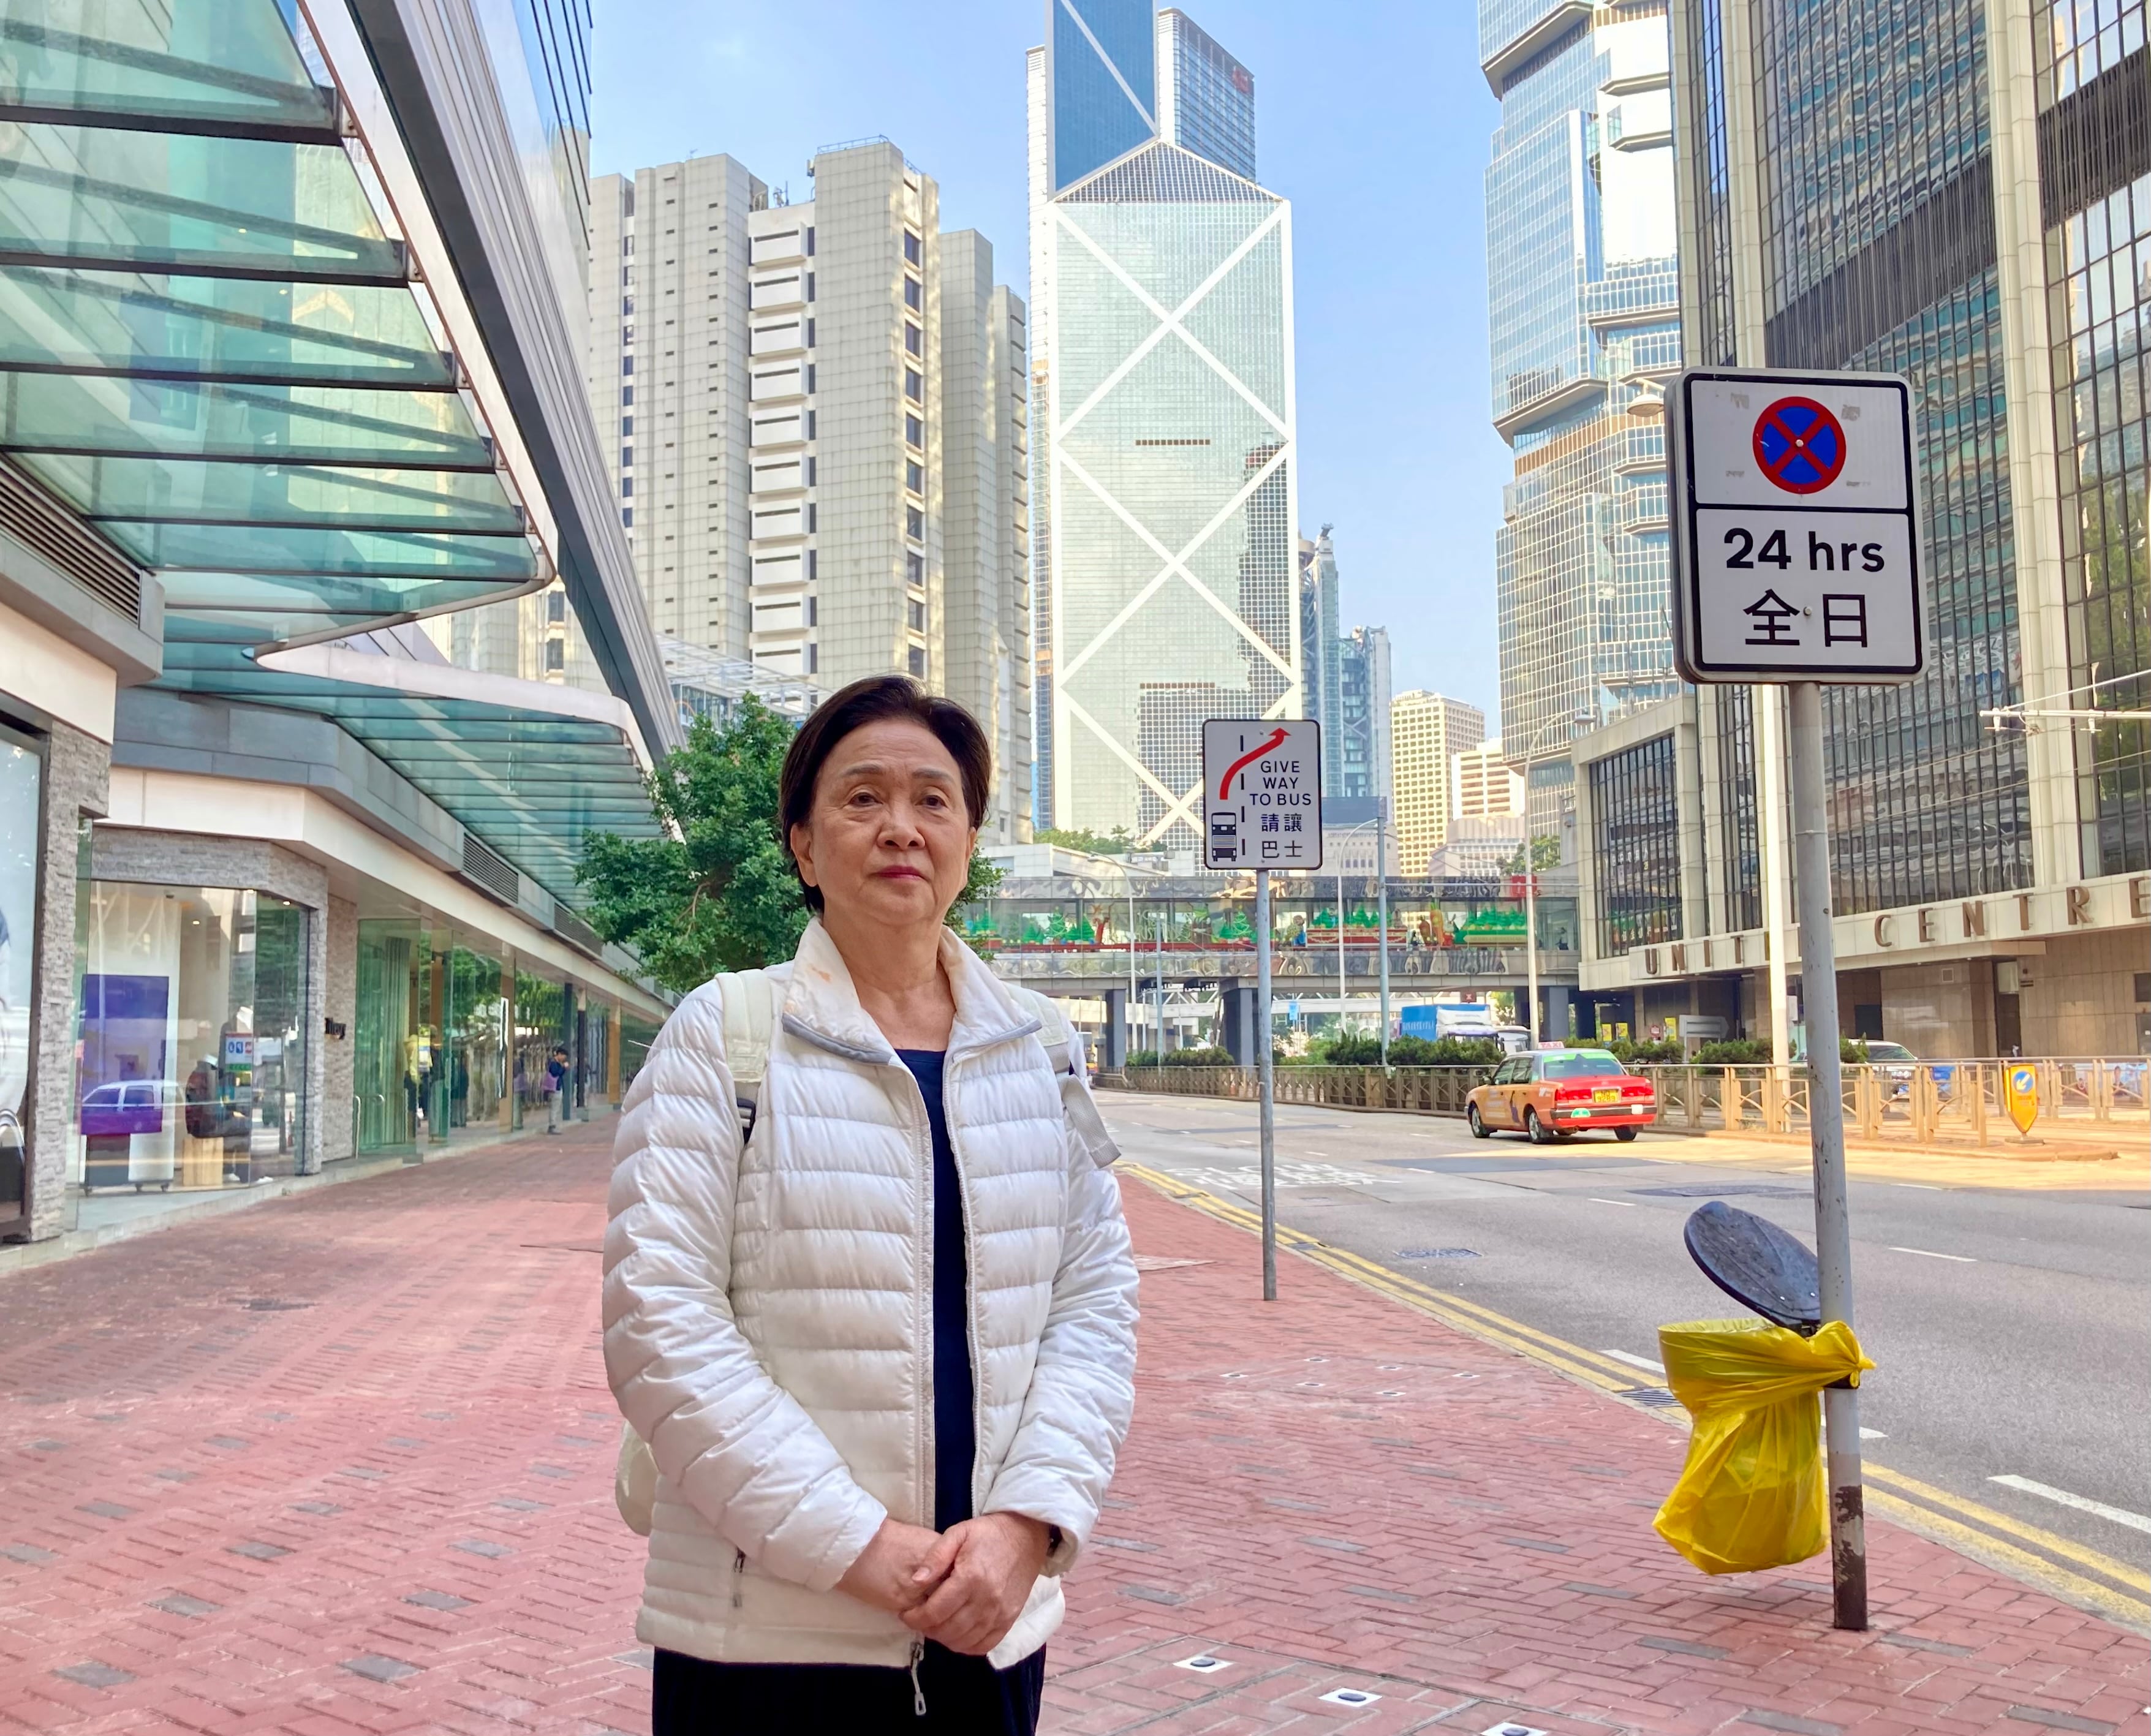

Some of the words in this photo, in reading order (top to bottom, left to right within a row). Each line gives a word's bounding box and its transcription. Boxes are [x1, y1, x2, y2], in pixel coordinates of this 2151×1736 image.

[1723, 527, 1791, 570] 24
[1808, 530, 1885, 572] hrs
[1742, 588, 1868, 648] 全日
[1260, 760, 1300, 773] GIVE
[1263, 777, 1299, 789] WAY
[1249, 793, 1271, 806] TO
[1277, 793, 1312, 806] BUS
[1260, 813, 1302, 832] 請讓
[1261, 840, 1303, 858] 巴士
[1644, 926, 1802, 975] UNIT
[1873, 876, 2151, 947] CENTRE
